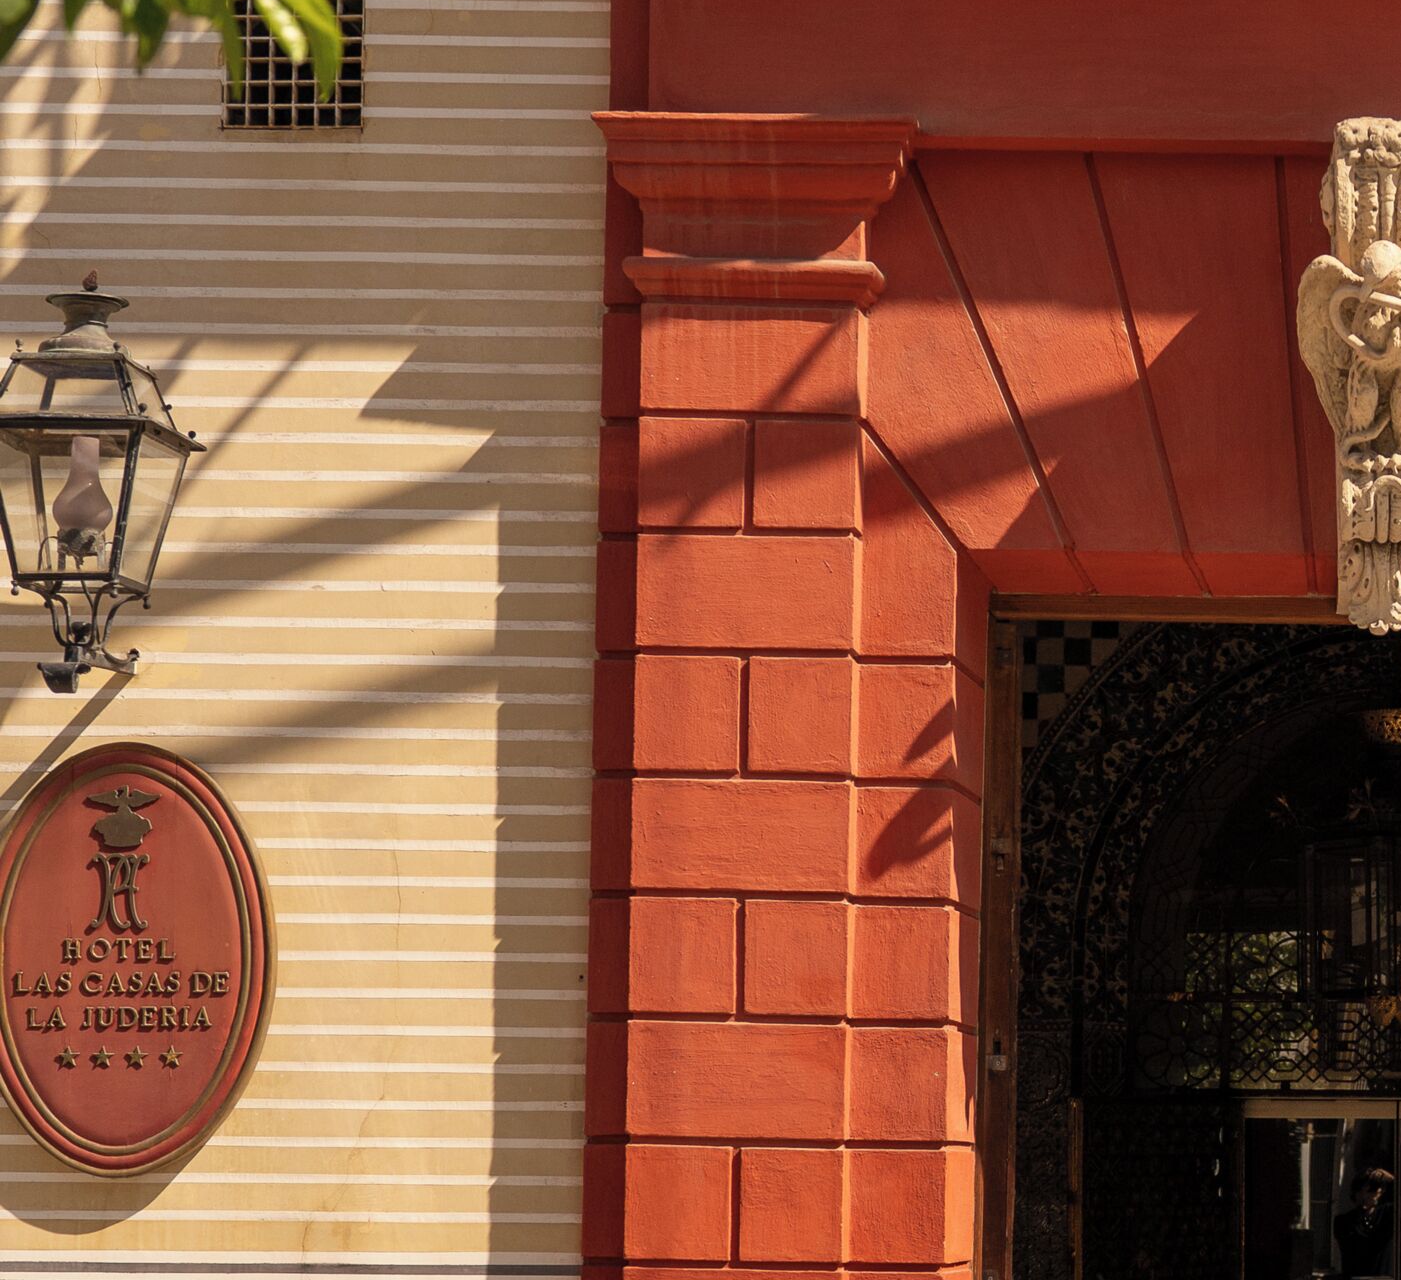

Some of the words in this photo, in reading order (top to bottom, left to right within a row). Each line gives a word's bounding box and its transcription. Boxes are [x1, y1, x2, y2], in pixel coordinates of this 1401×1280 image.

[62, 937, 176, 961] HOTEL
[14, 970, 73, 994] LAS
[79, 970, 182, 994] CASAS
[190, 970, 231, 994] DE
[27, 1006, 67, 1029] LA
[81, 1005, 213, 1029] JUDERIA
